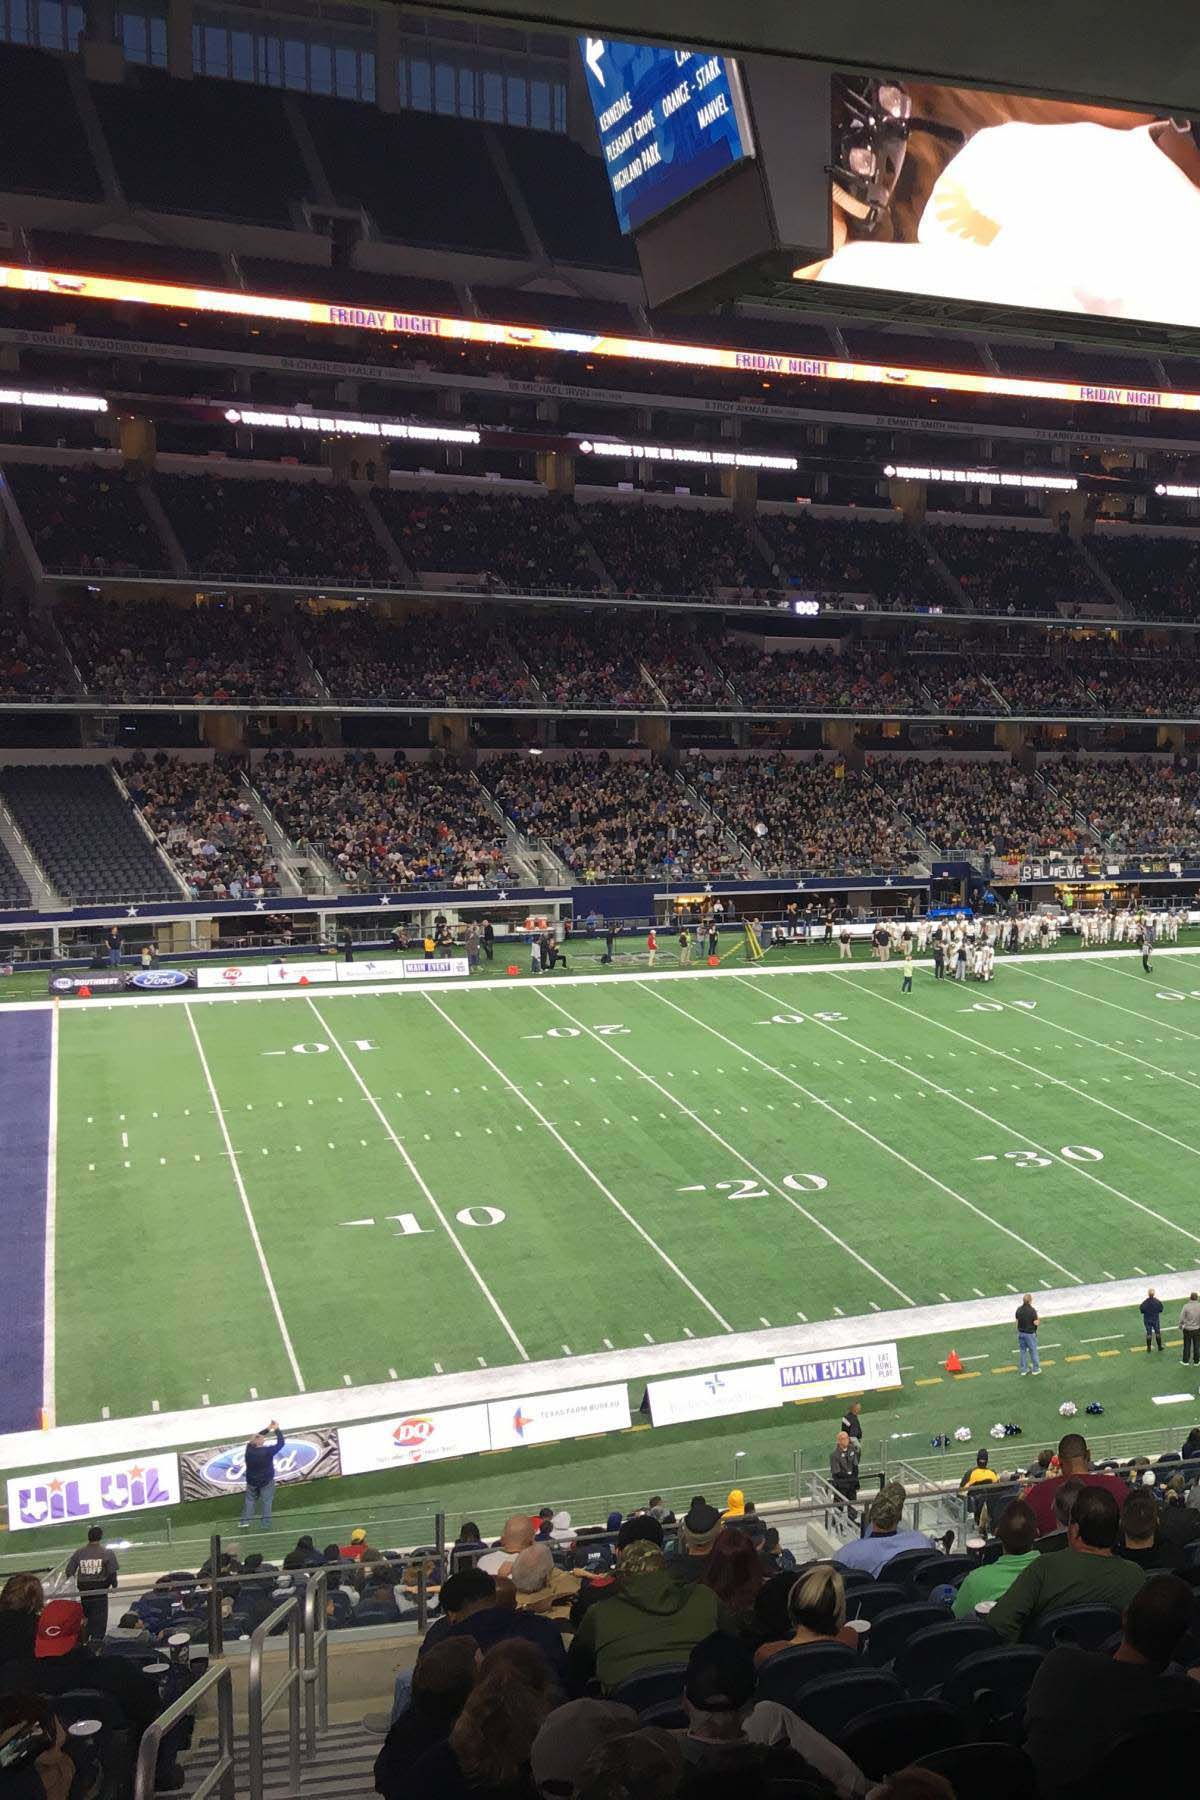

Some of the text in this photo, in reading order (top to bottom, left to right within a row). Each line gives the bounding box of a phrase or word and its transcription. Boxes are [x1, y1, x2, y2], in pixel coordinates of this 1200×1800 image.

[662, 82, 691, 119] ORANGE
[696, 56, 722, 90] STARK
[599, 92, 633, 132] KENNEDALE
[697, 93, 729, 130] MANVEL
[605, 111, 656, 163] PLEASANT GROVE
[613, 143, 662, 192] HIGHLAND PARK
[329, 306, 442, 335] FRIDAY NIGHT
[735, 353, 829, 376] FRIDAY NIGHT
[1080, 386, 1162, 406] FRIDAY NIGHT
[1022, 865, 1085, 879] BELIEVE
[429, 962, 451, 971] EVENT
[74, 978, 118, 987] SOUTHWEST
[143, 973, 177, 986] Ford
[972, 999, 1039, 1013] 40
[771, 1010, 849, 1024] 30
[546, 1023, 632, 1038] 20
[292, 1039, 381, 1055] 10
[1004, 1145, 1105, 1168] 30
[714, 1173, 830, 1201] 20
[385, 1206, 507, 1237] 10
[783, 1358, 863, 1385] MAIN EVENT
[566, 1406, 588, 1415] FARM
[589, 1400, 620, 1411] BUREAU
[399, 1423, 430, 1441] DQ
[80, 1559, 103, 1568] EVENT
[81, 1567, 103, 1575] STAFF
